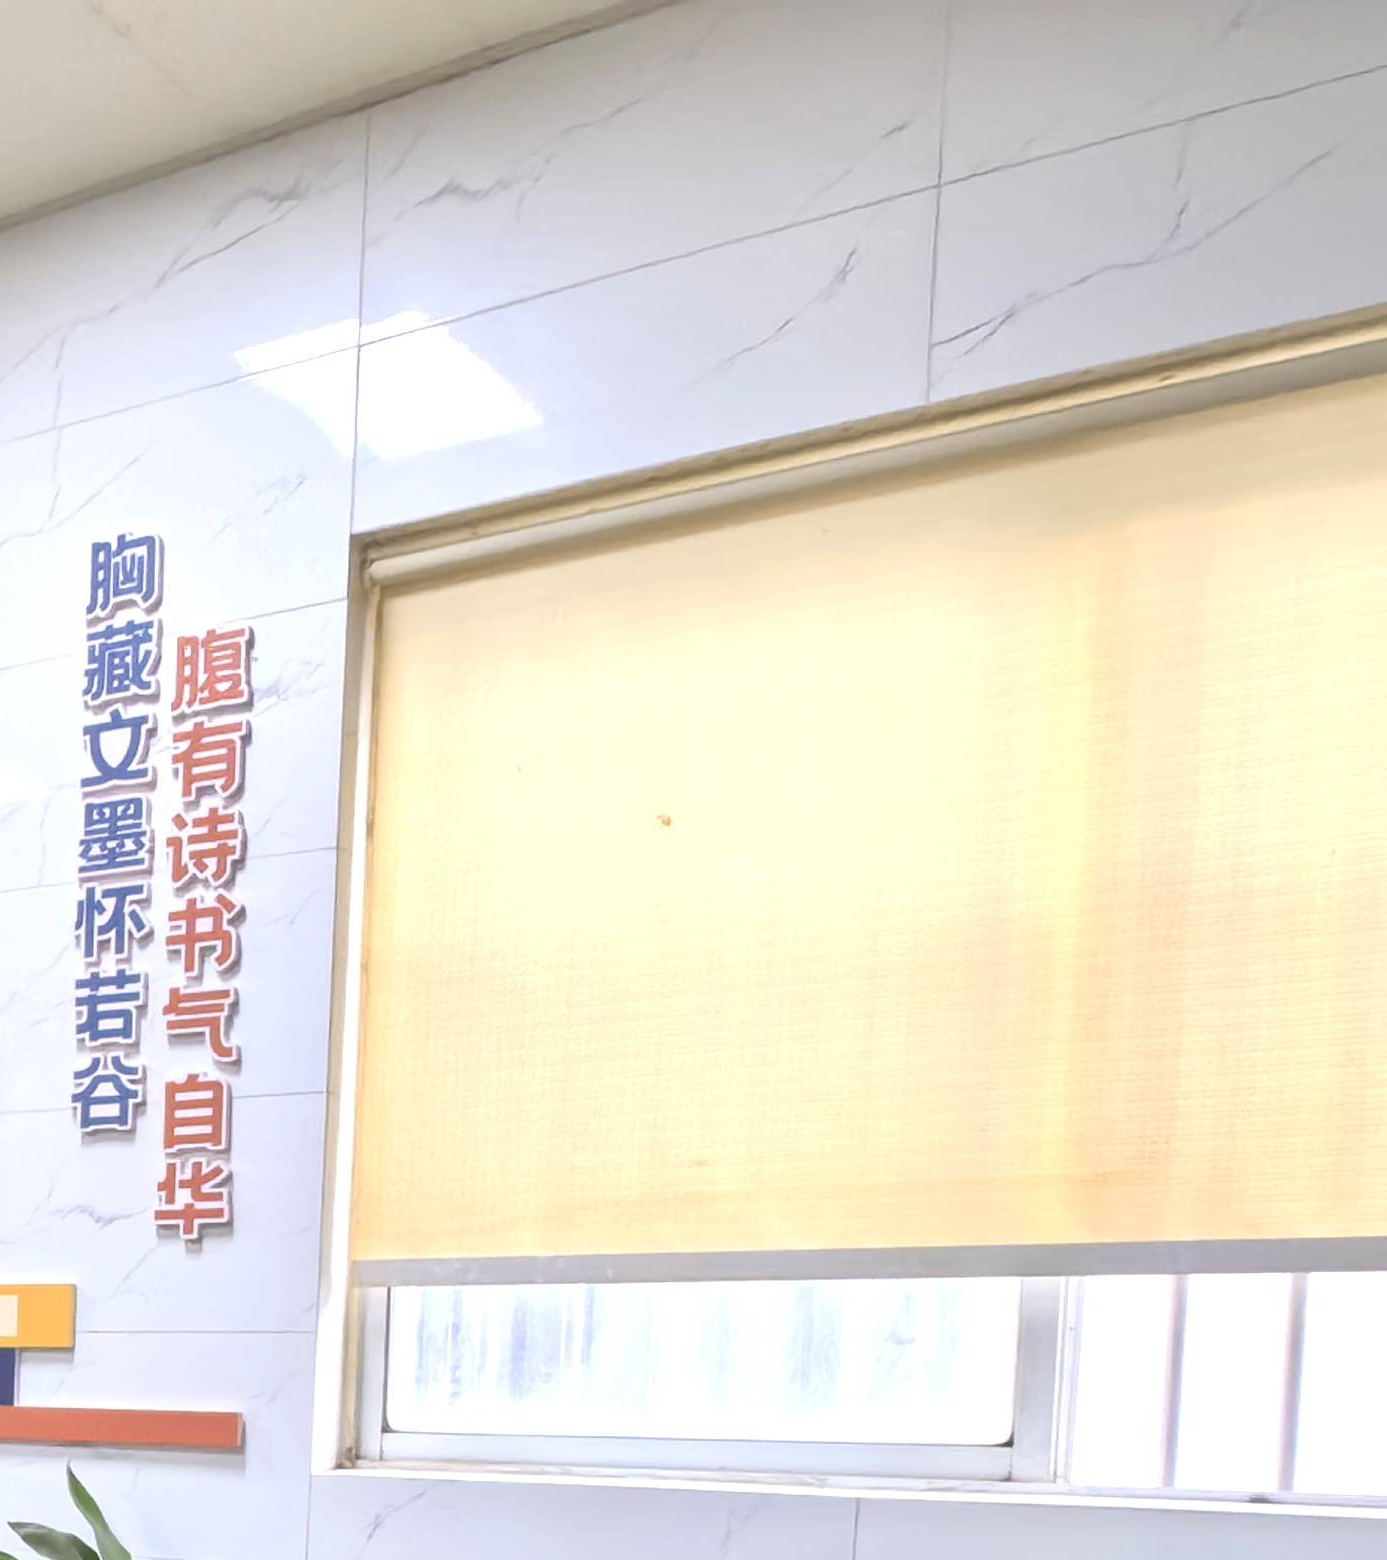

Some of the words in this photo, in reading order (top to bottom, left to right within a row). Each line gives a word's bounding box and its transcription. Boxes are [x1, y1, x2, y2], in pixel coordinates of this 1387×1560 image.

[72, 534, 156, 1129] 胸藏文墨怀若谷
[154, 628, 246, 1236] 腹有诗书气自华
